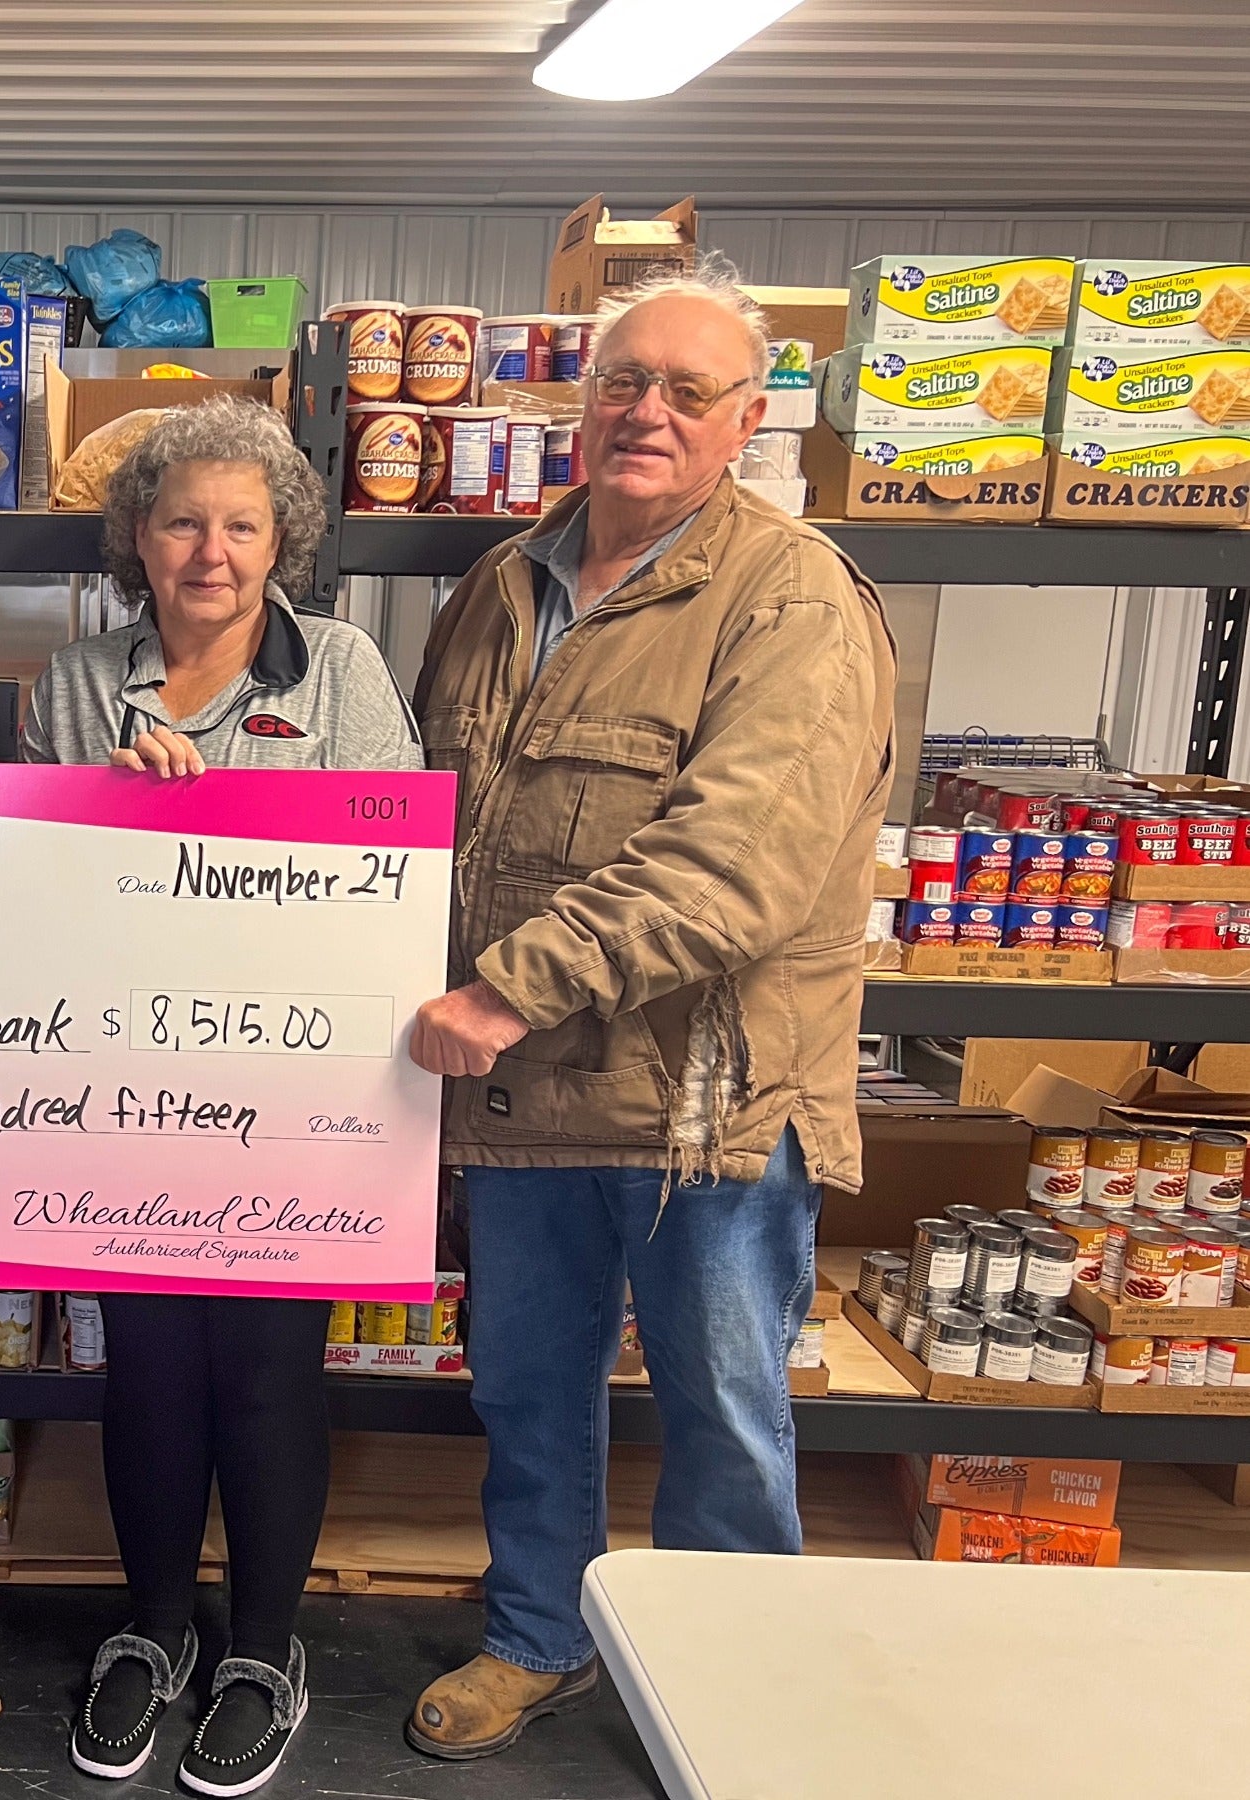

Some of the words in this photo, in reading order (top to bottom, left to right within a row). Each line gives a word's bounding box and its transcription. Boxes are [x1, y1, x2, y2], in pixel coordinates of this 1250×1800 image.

[931, 273, 970, 288] Unsalted
[973, 271, 993, 281] Tops
[1134, 278, 1172, 292] Unsalted
[1175, 277, 1194, 287] Tops
[926, 285, 997, 313] Saltine
[1129, 290, 1198, 317] Saltine
[31, 304, 62, 321] Twinkles
[946, 308, 982, 321] crackers
[1148, 314, 1183, 326] crackers
[348, 359, 401, 376] CRUMBS
[406, 364, 466, 379] CRUMBS
[912, 361, 950, 375] Unsalted
[952, 358, 972, 369] Tops
[1124, 364, 1163, 378] Unsalted
[1165, 362, 1186, 372] Tops
[907, 372, 977, 399] Saltine
[1118, 376, 1189, 402] Saltine
[927, 395, 962, 407] crackers
[1138, 399, 1175, 411] crackers
[905, 449, 943, 463] Unsalted
[945, 447, 965, 457] Tops
[1113, 450, 1151, 464] Unsalted
[1153, 448, 1173, 458] Tops
[360, 462, 420, 479] CRUMBS
[1066, 483, 1249, 508] CRACKERS
[347, 797, 408, 820] 1001
[173, 843, 340, 905] November
[348, 853, 409, 900] 24
[118, 876, 166, 894] Date
[103, 1006, 121, 1038] $
[151, 994, 332, 1052] 8,515.00
[108, 1086, 257, 1148] fifteen
[309, 1115, 383, 1135] Dollars
[14, 1189, 242, 1228] Wheatland
[236, 1196, 385, 1235] Electric
[92, 1237, 211, 1260] Authorized
[205, 1240, 300, 1268] Signature
[378, 1349, 416, 1360] FAMILY
[945, 1457, 1029, 1483] Express
[1050, 1469, 1102, 1491] CHICKEN
[1053, 1487, 1098, 1508] FLAVOR
[1040, 1548, 1084, 1561] CHICKEN
